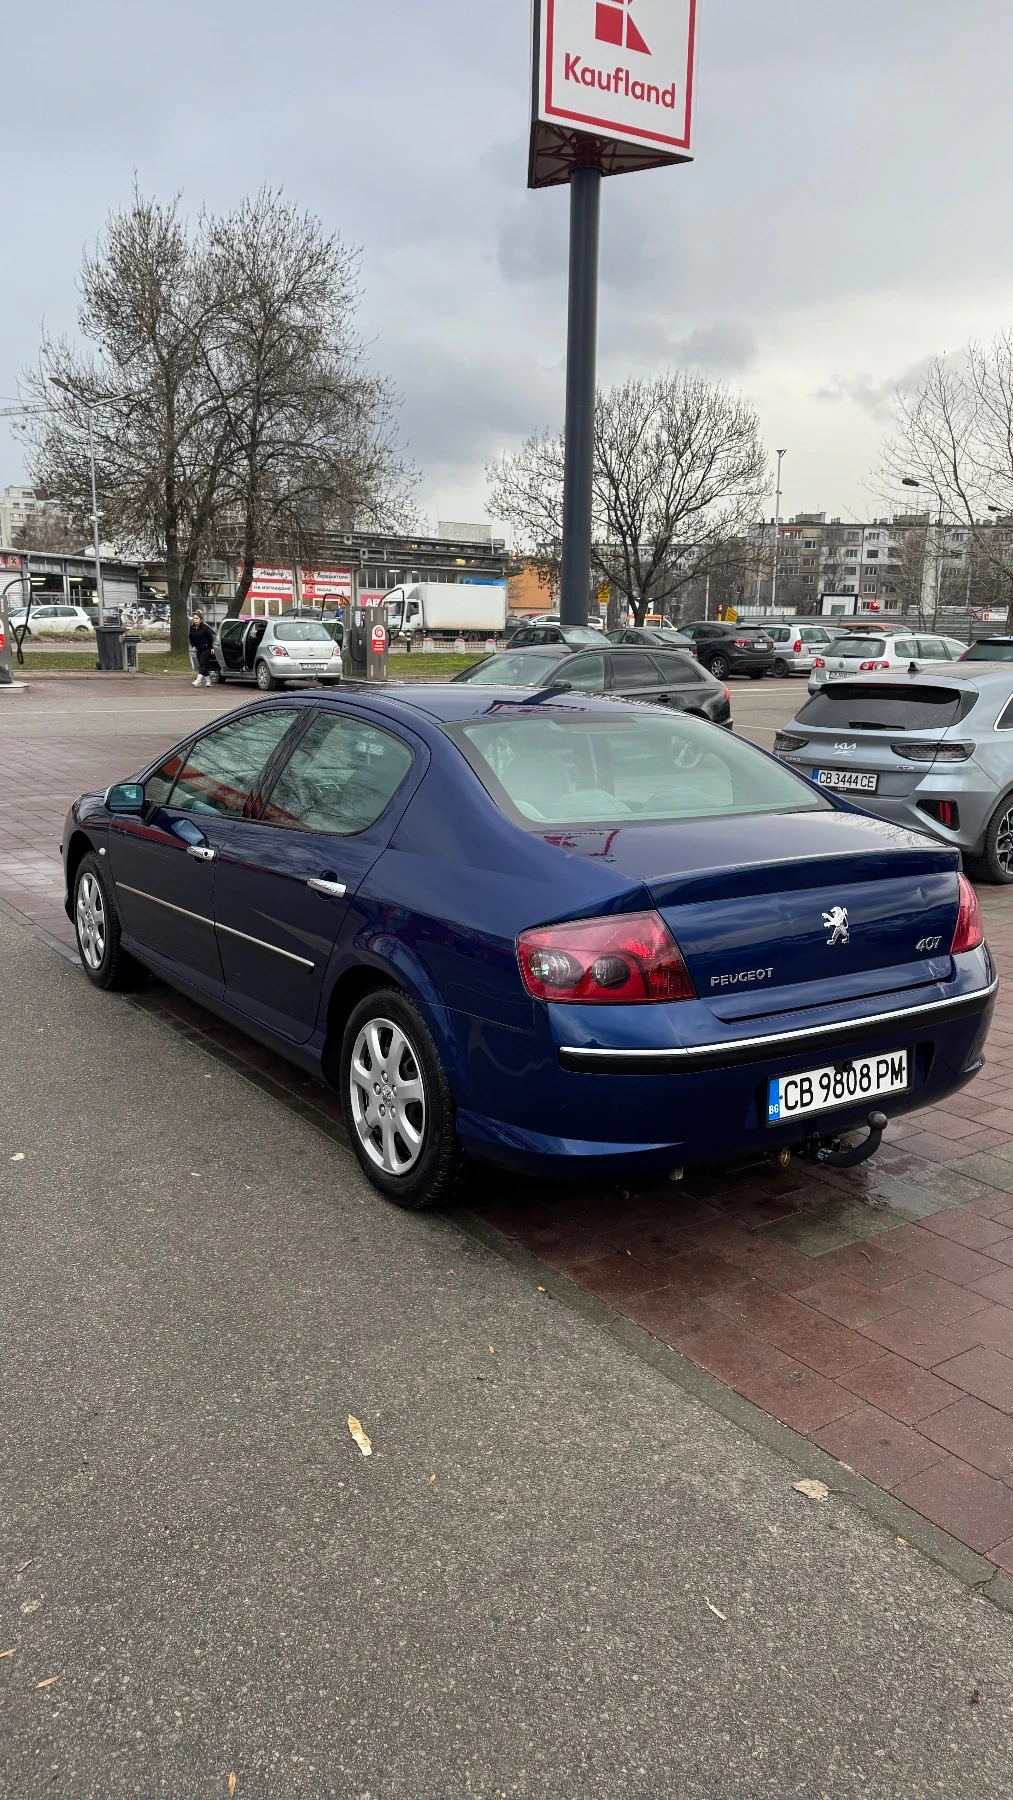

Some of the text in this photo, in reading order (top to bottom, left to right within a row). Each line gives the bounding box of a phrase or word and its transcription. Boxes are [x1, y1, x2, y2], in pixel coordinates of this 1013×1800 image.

[564, 52, 676, 109] Kaufland
[834, 741, 857, 750] KIA
[819, 771, 875, 788] CB 3444 CE
[915, 935, 942, 952] 407
[710, 967, 774, 987] PEUGEOT
[768, 1055, 904, 1115] BG CB 9808 PM
